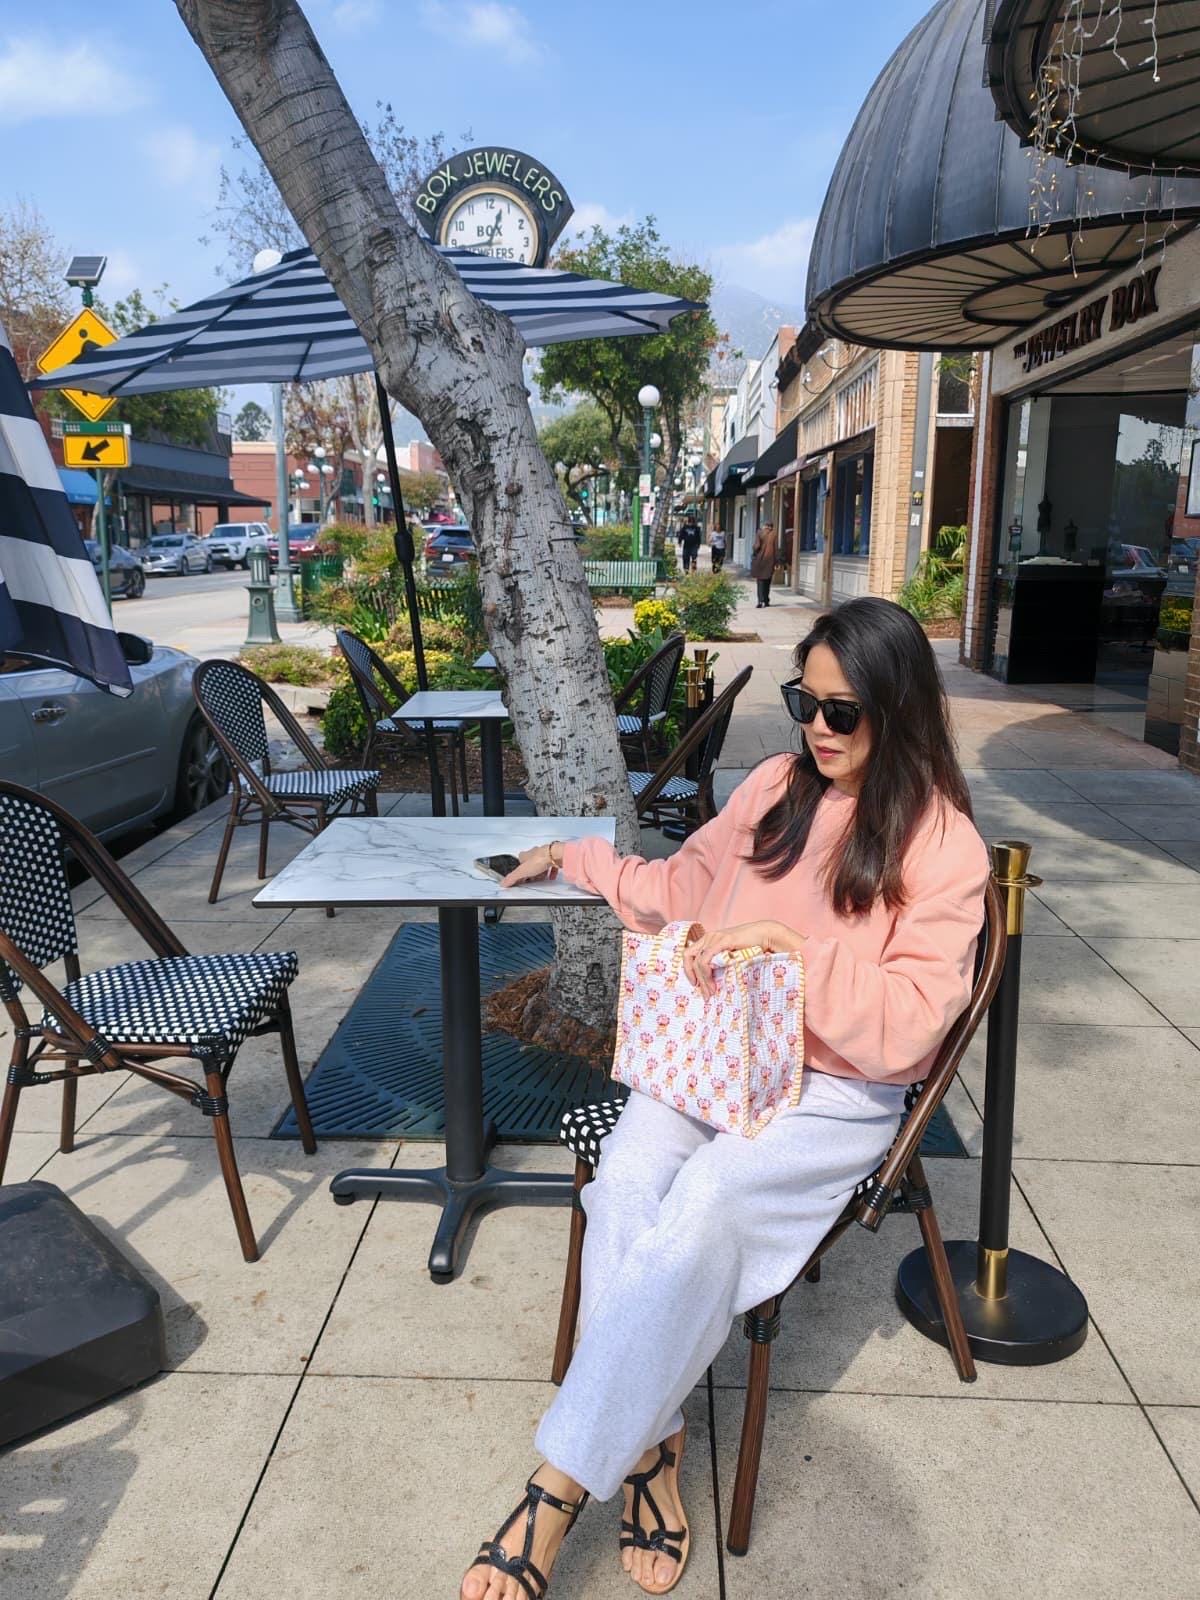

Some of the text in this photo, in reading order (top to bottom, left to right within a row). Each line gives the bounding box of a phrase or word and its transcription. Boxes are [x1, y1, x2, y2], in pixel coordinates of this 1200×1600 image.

[416, 152, 562, 214] BOX JEWELERS
[485, 198, 495, 209] 12
[467, 204, 475, 216] 11
[455, 220, 465, 231] 10
[518, 219, 525, 230] 2
[476, 225, 503, 238] BOX
[523, 237, 530, 248] 3
[1022, 265, 1162, 374] JEWELRY BOX
